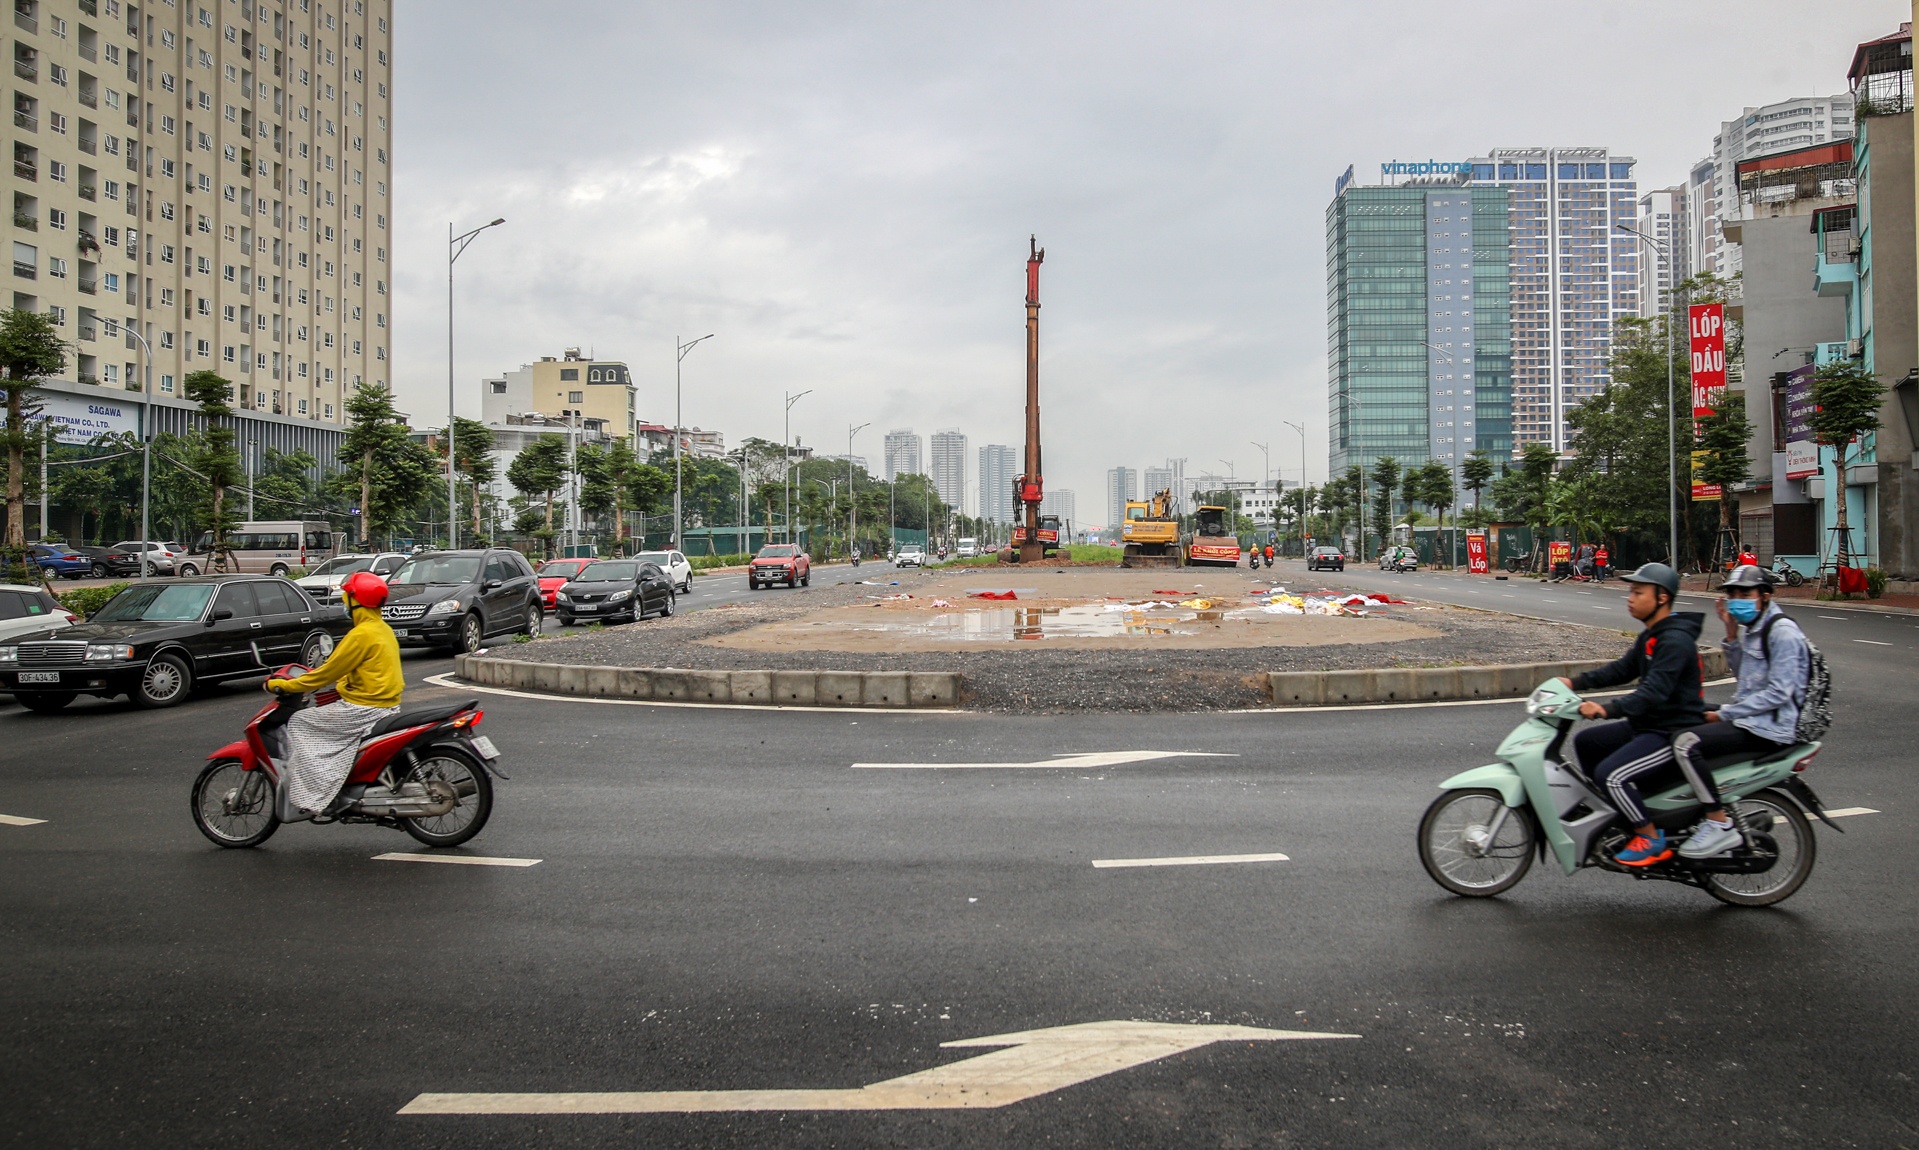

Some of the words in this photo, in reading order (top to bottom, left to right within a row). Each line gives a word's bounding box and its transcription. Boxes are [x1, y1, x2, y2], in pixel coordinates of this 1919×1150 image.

[1381, 159, 1473, 176] vinaphone
[1692, 308, 1721, 338] LỐP
[1693, 343, 1723, 373] DẦU
[1693, 380, 1706, 408] ẮC
[88, 405, 121, 418] SAGAWA
[96, 421, 110, 429] LTD.
[77, 429, 92, 437] NAM
[1470, 542, 1482, 553] Vá
[1551, 545, 1569, 555] LỐP
[1470, 556, 1486, 571] Lốp
[20, 673, 59, 682] 30F-434.36
